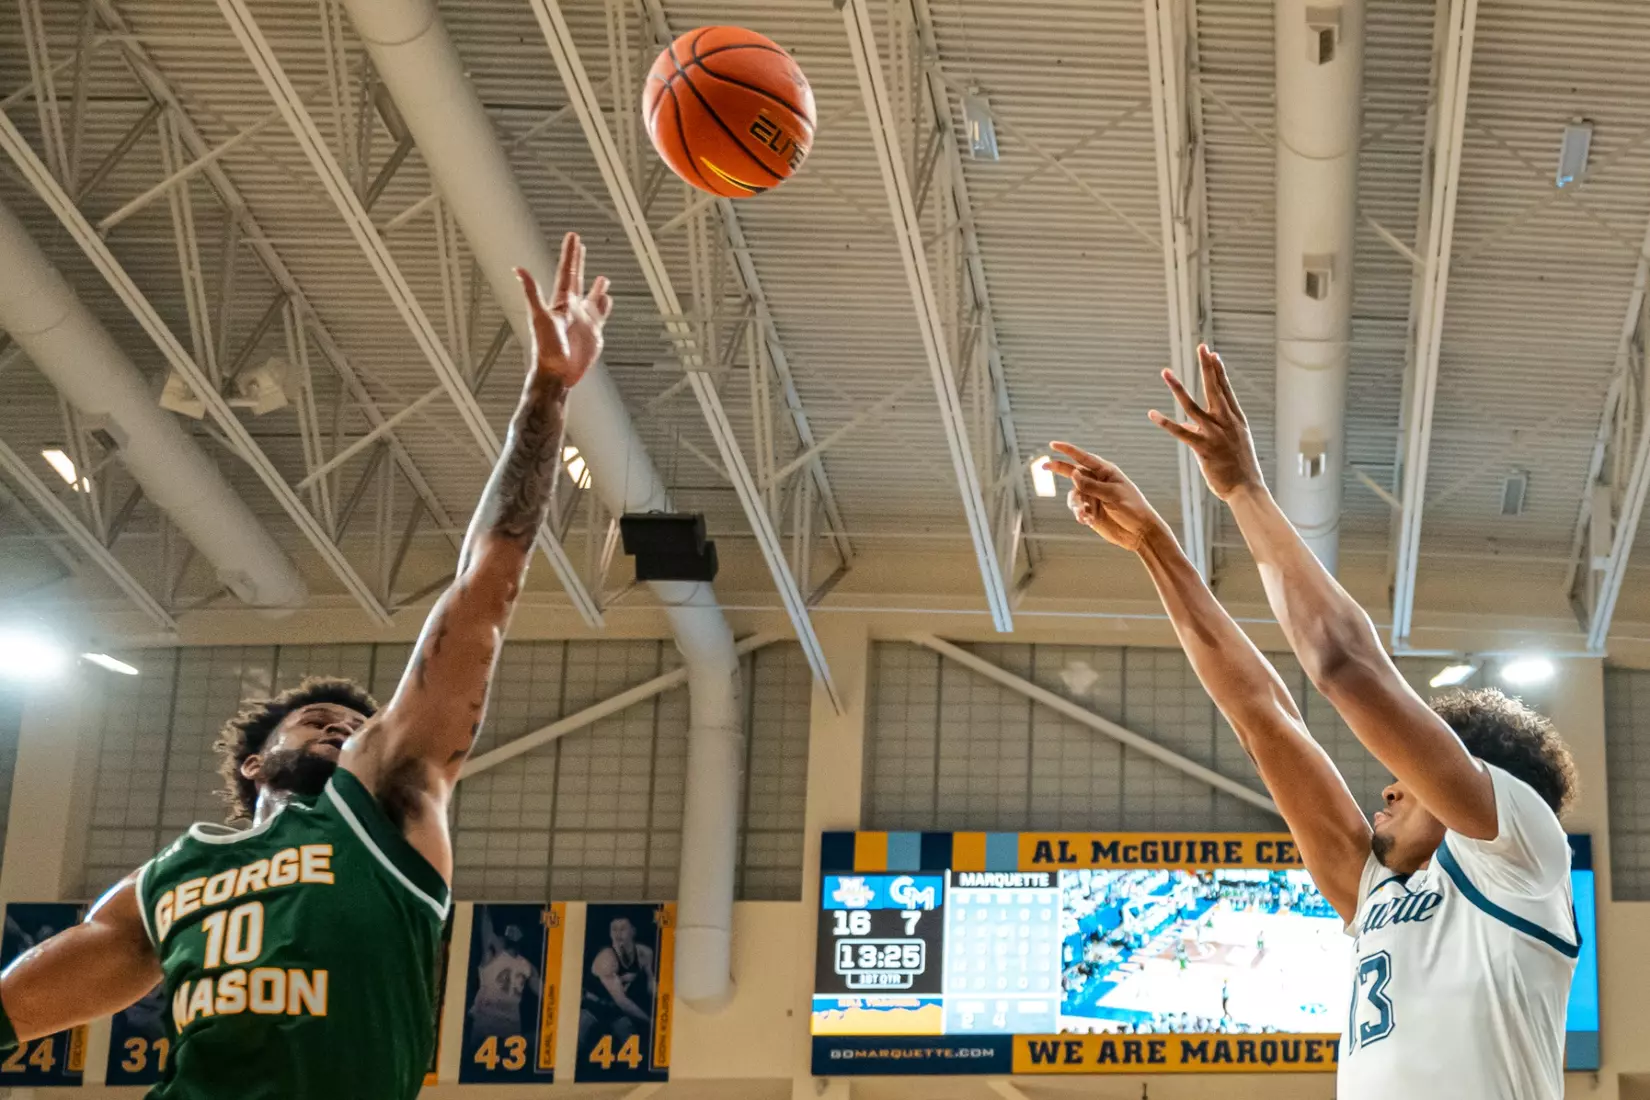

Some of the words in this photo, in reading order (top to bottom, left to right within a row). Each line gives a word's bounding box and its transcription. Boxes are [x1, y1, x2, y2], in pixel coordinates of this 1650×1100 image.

[1032, 841, 1077, 864] AL
[1091, 840, 1242, 864] McGUIRE
[1256, 841, 1303, 864] CE
[155, 844, 335, 942] GEORGE
[958, 871, 1050, 888] MARQUETTE
[201, 901, 264, 969] 10
[833, 910, 871, 935] 16
[901, 911, 921, 935] 7
[841, 944, 921, 968] 13:25
[172, 967, 328, 1035] MASON
[1, 1037, 56, 1073] 24
[121, 1037, 170, 1073] 31
[474, 1034, 527, 1070] 43
[589, 1034, 643, 1069] 44
[830, 1047, 994, 1060] GOMARQUETTE.COM
[1028, 1040, 1084, 1064] WE
[1097, 1040, 1166, 1064] ARE
